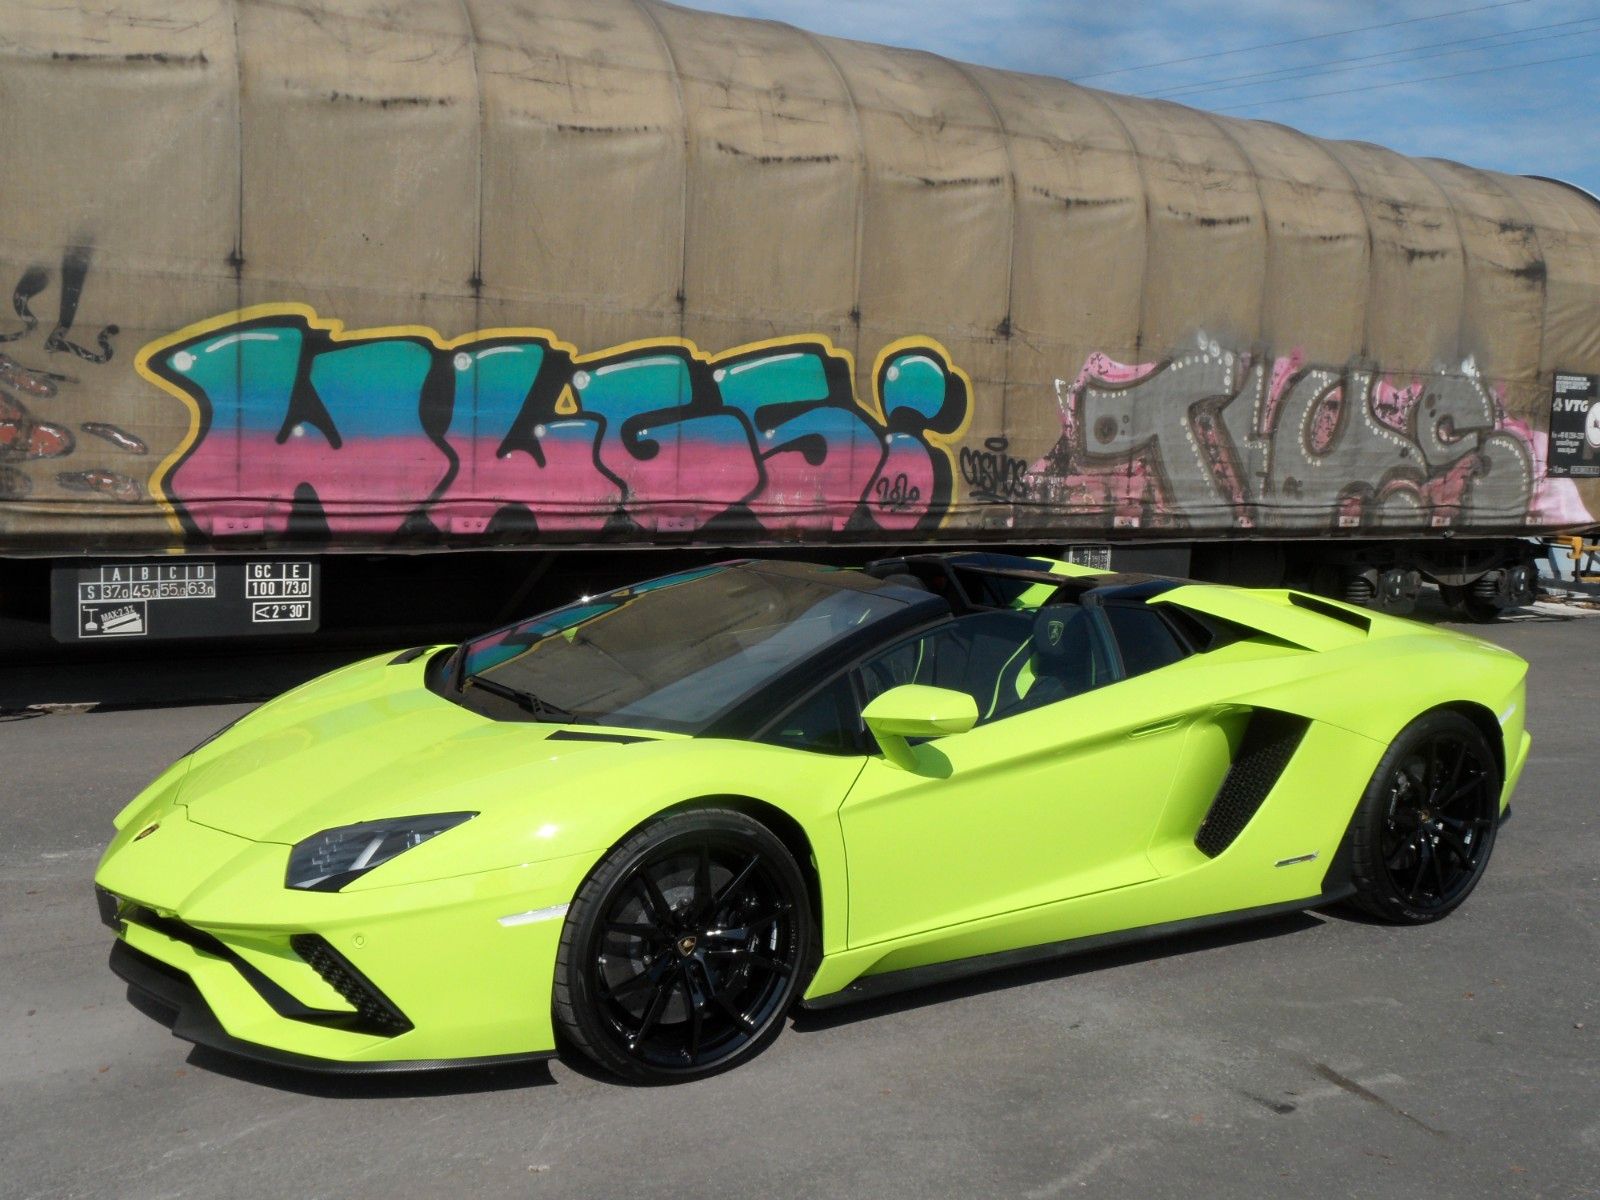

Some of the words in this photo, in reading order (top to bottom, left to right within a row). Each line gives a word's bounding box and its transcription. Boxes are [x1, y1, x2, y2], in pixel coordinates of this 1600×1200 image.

[1564, 398, 1589, 413] VTG
[112, 567, 121, 581] A
[141, 566, 149, 580] B
[169, 566, 177, 580] C
[197, 565, 205, 579] D
[254, 564, 272, 578] GC
[292, 564, 300, 578] E
[87, 586, 95, 599] S
[252, 581, 275, 595] 100
